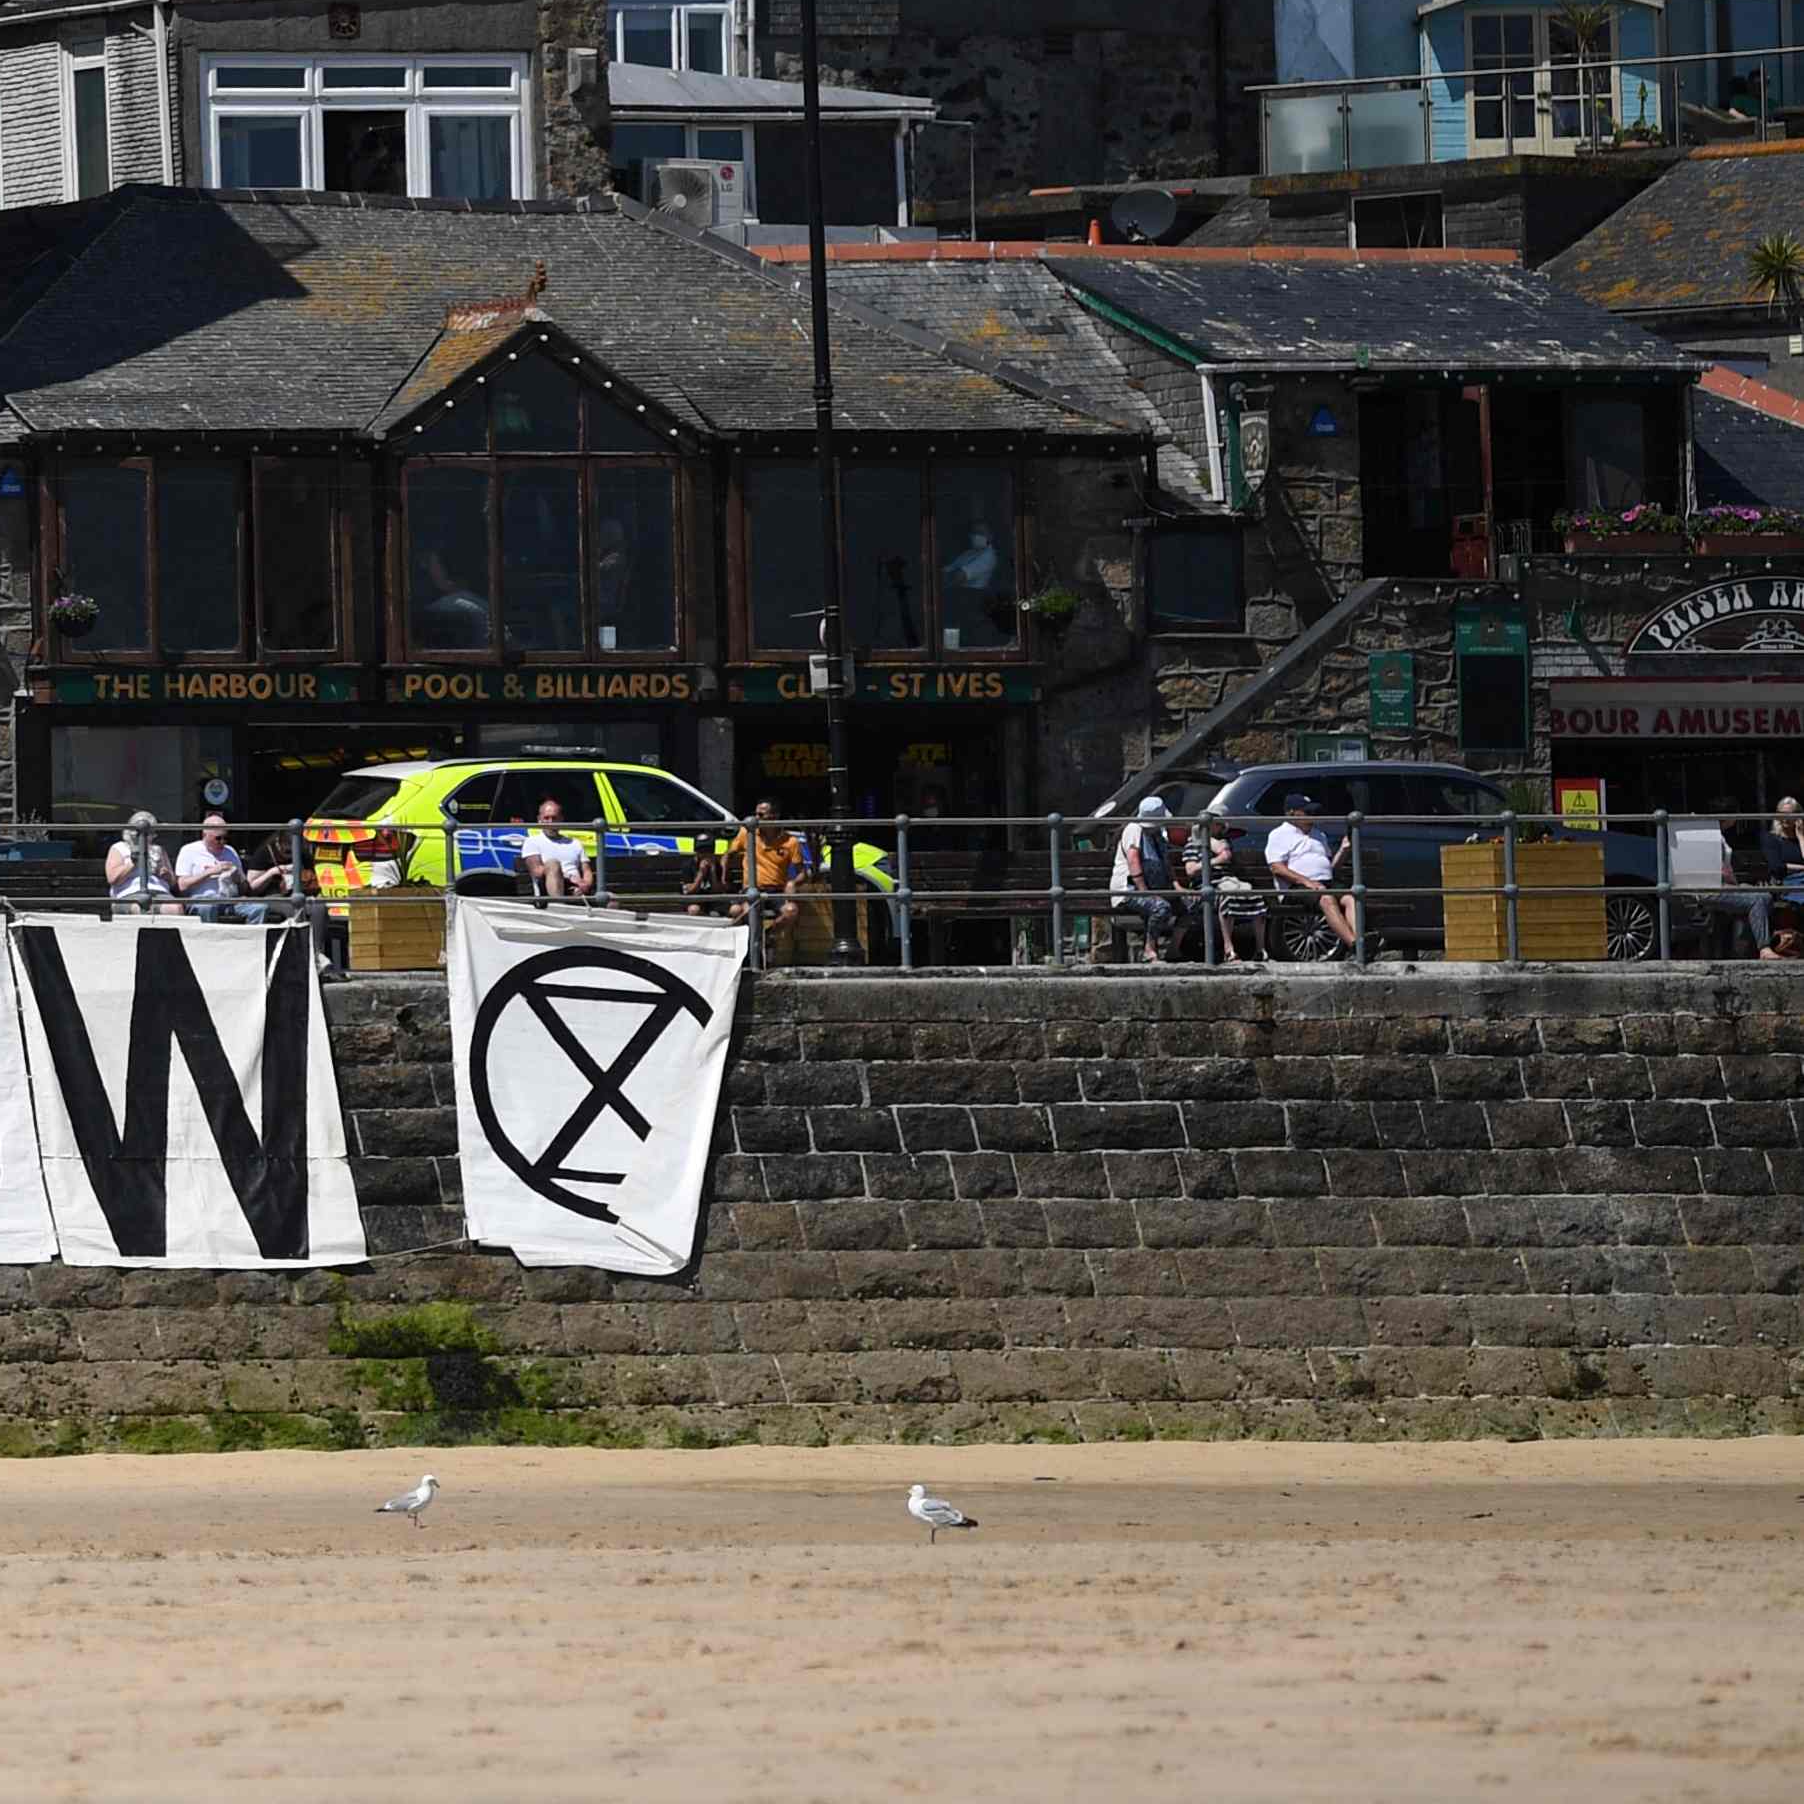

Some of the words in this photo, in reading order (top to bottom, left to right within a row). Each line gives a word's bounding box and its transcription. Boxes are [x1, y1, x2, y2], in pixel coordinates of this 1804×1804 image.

[720, 182, 734, 193] LG
[93, 673, 152, 700] THE
[163, 673, 318, 700] HARBOUR
[403, 673, 490, 700] POOL
[502, 673, 526, 699] &
[535, 673, 690, 700] BILLIARDS
[888, 672, 926, 700] ST
[936, 672, 1005, 699] IVES
